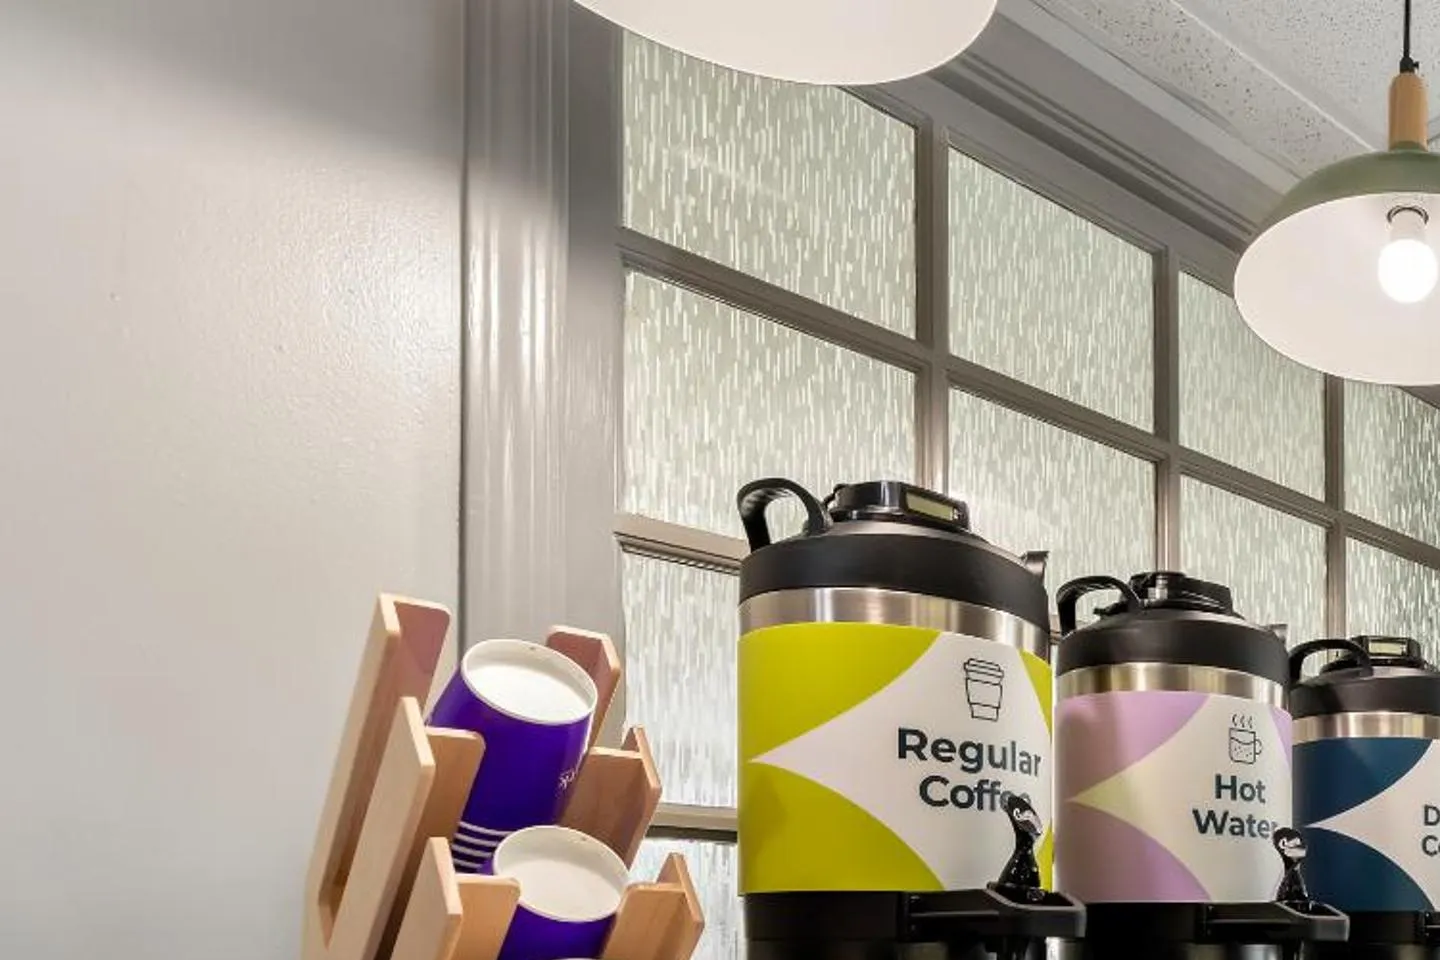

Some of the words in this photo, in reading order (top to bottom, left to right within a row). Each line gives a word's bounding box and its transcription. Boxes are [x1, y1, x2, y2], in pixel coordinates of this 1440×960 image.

[897, 727, 1042, 777] Regular
[919, 775, 1031, 812] Coff
[1215, 773, 1266, 804] Hot
